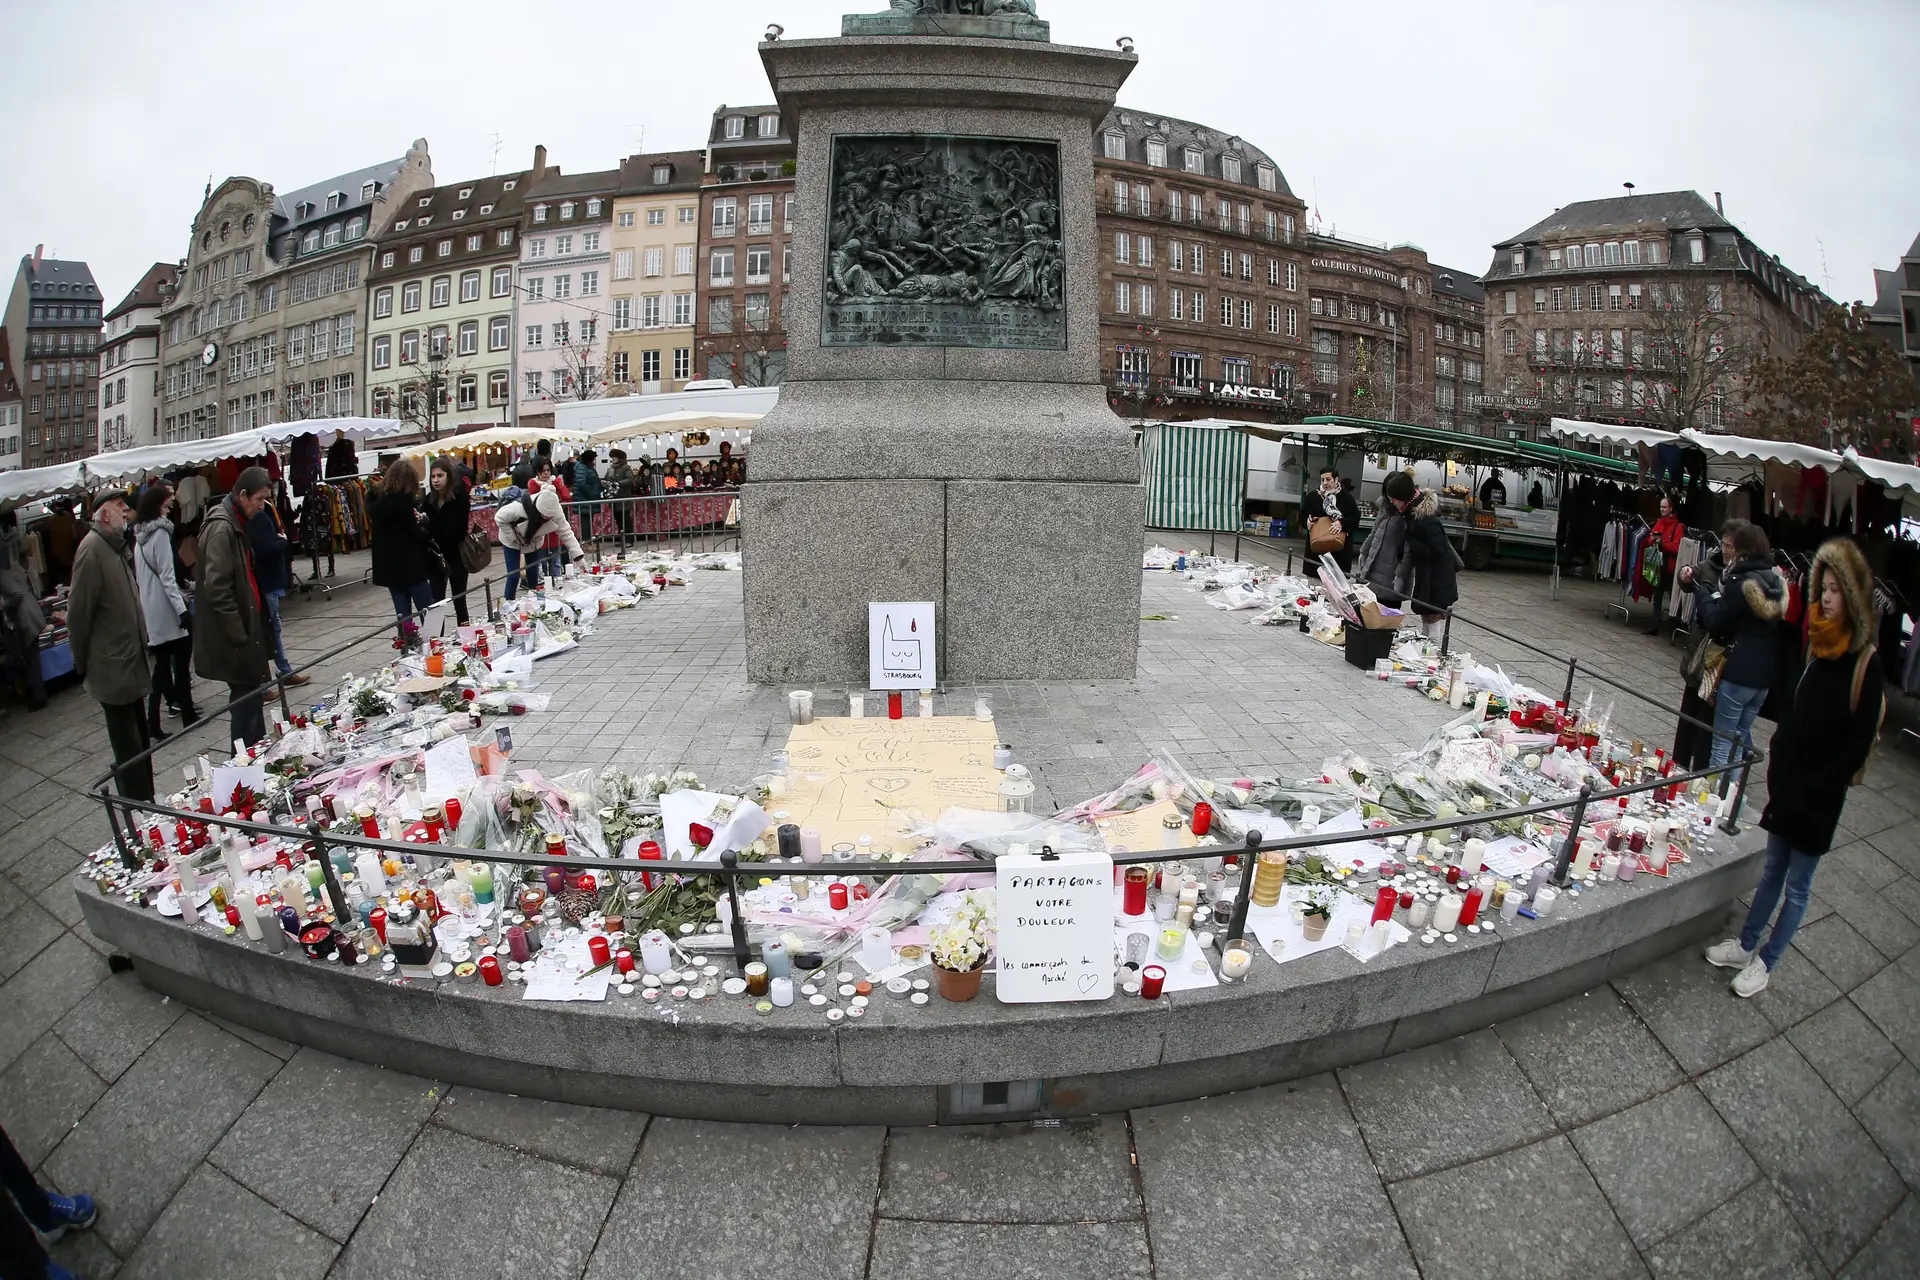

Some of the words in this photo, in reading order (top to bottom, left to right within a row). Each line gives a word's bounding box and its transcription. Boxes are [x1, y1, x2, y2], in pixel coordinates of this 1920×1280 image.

[1311, 258, 1357, 272] GALERIES
[1358, 265, 1398, 283] LAFAYETTE
[883, 672, 922, 680] STRASBOURG
[1036, 899, 1072, 908] VOTRE
[1017, 917, 1076, 928] DOULEUR
